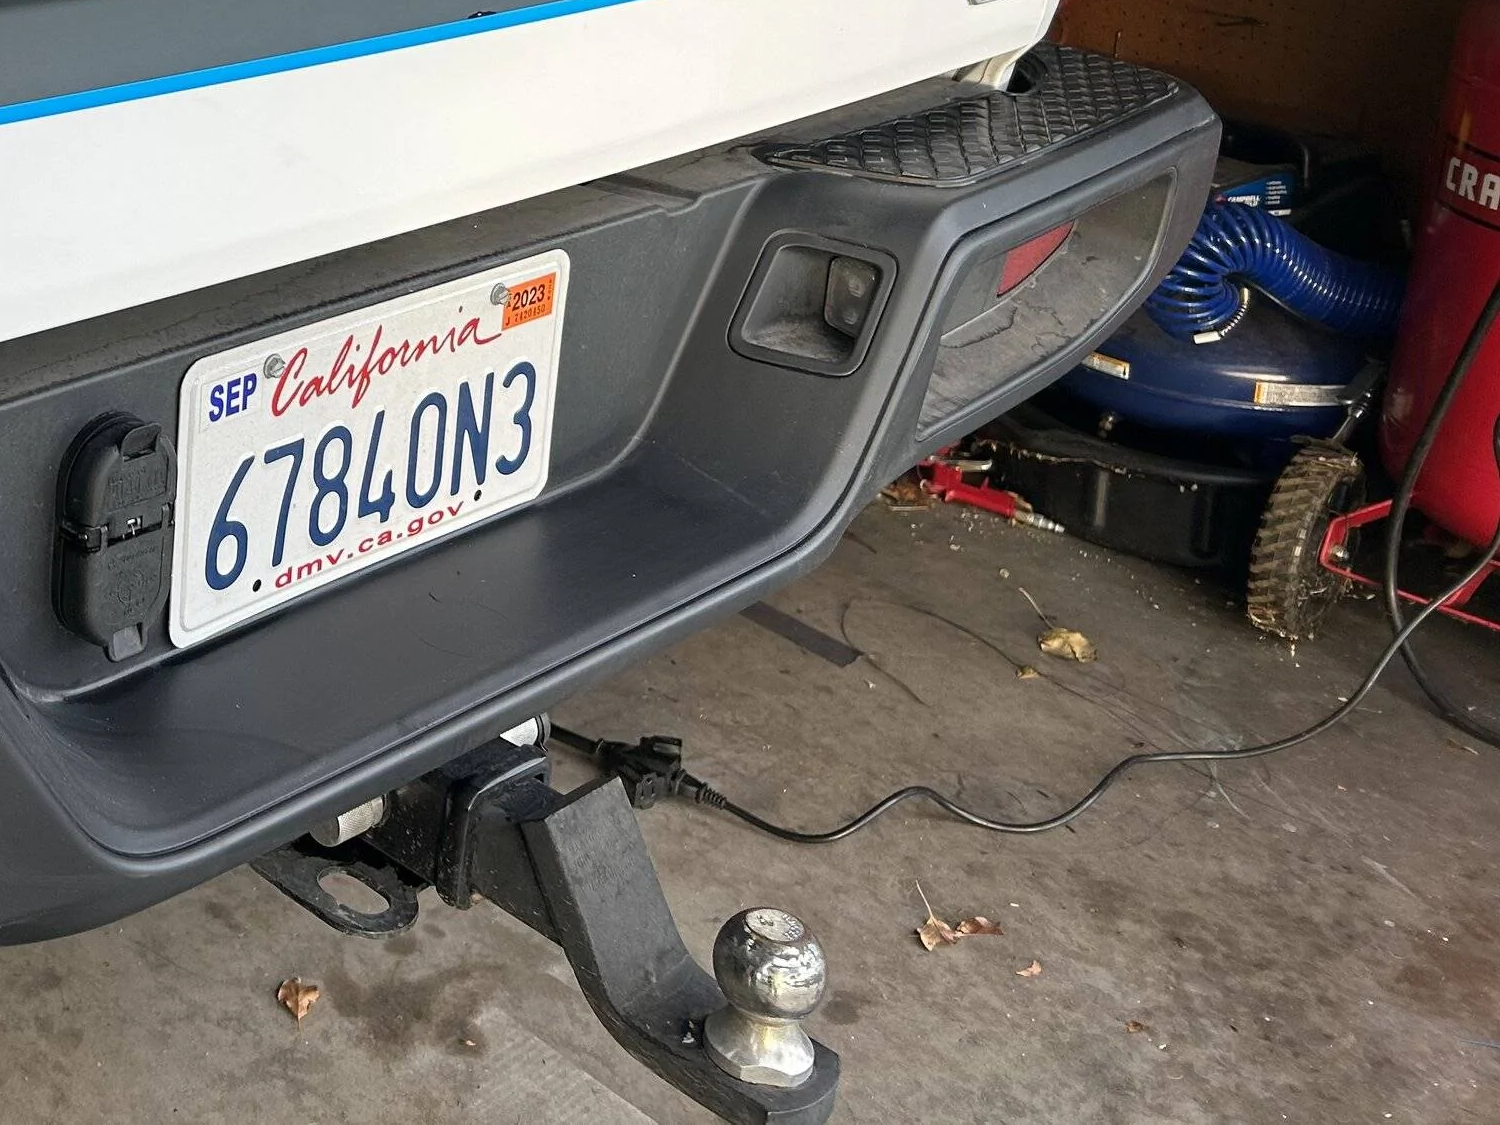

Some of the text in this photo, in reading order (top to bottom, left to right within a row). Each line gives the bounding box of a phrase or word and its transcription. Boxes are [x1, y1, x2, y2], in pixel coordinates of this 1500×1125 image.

[512, 284, 546, 312] 2023
[209, 372, 258, 423] SEP
[271, 306, 501, 417] California
[205, 360, 537, 591] 67840N3
[274, 500, 465, 589] dmv.ca.gov
